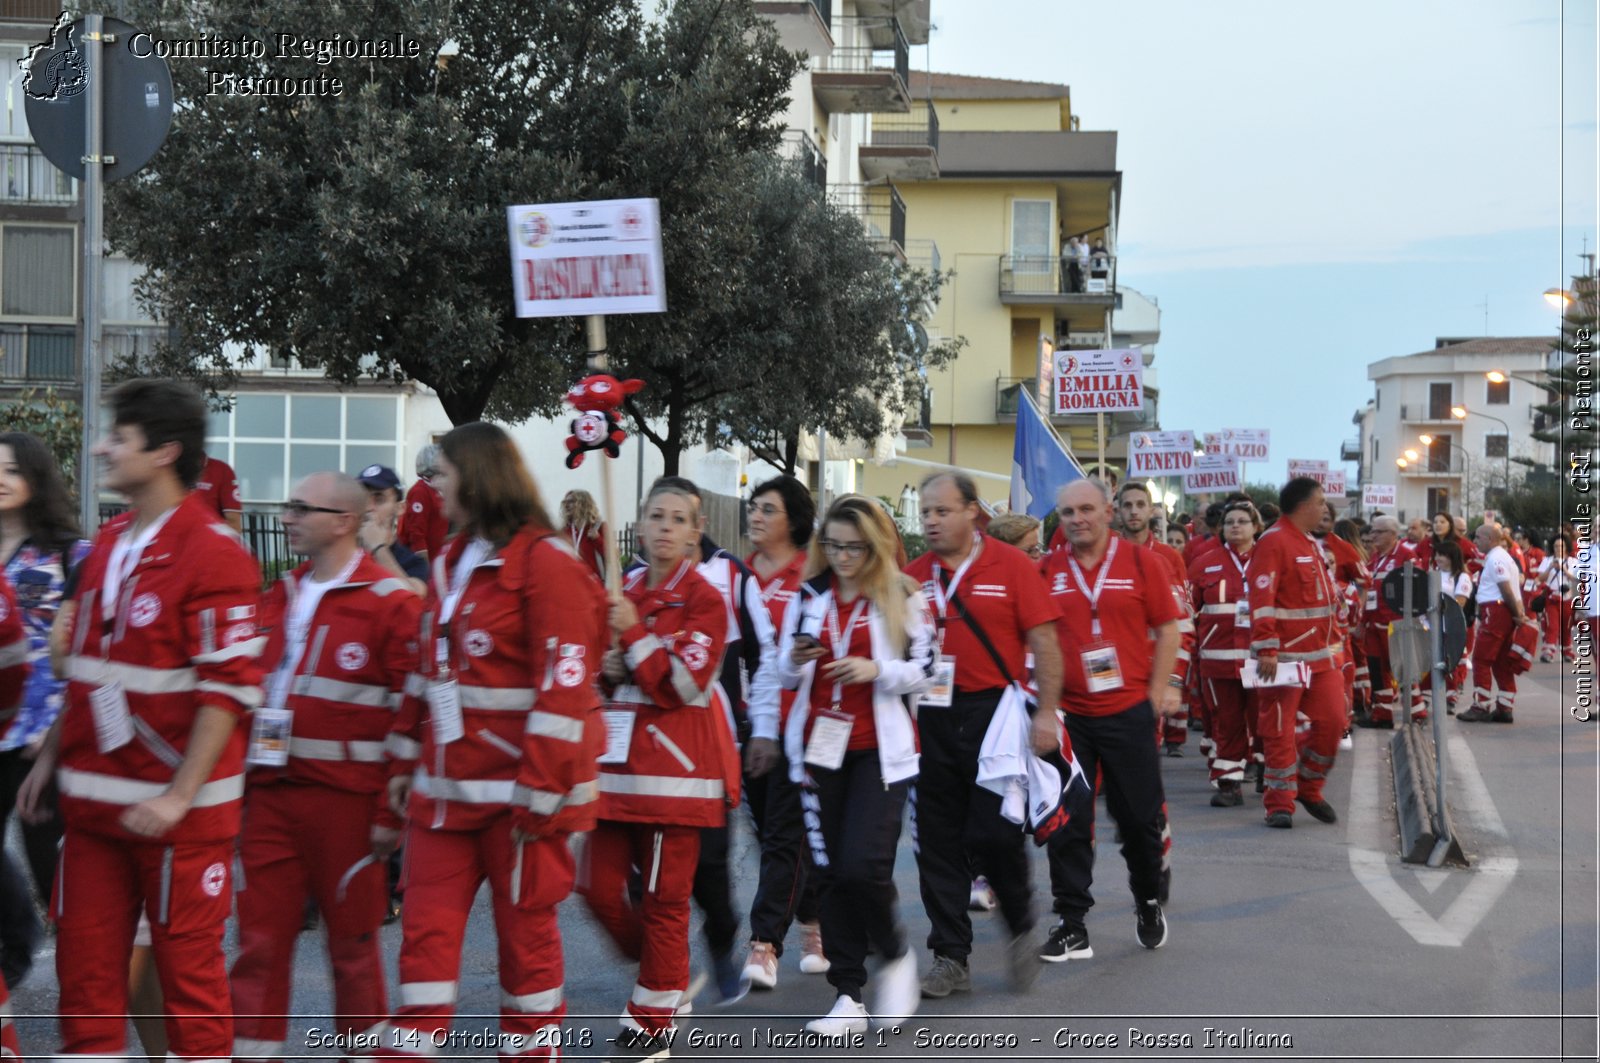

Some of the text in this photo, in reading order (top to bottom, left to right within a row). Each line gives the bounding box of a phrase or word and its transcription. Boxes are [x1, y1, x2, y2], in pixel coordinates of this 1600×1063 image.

[521, 253, 655, 300] BASILICATA
[1059, 374, 1140, 393] EMILIA
[1059, 391, 1140, 409] ROMAGNA
[1134, 451, 1192, 471] VENETO
[1187, 471, 1237, 489] CAMPANIA
[1365, 494, 1378, 504] ALTO
